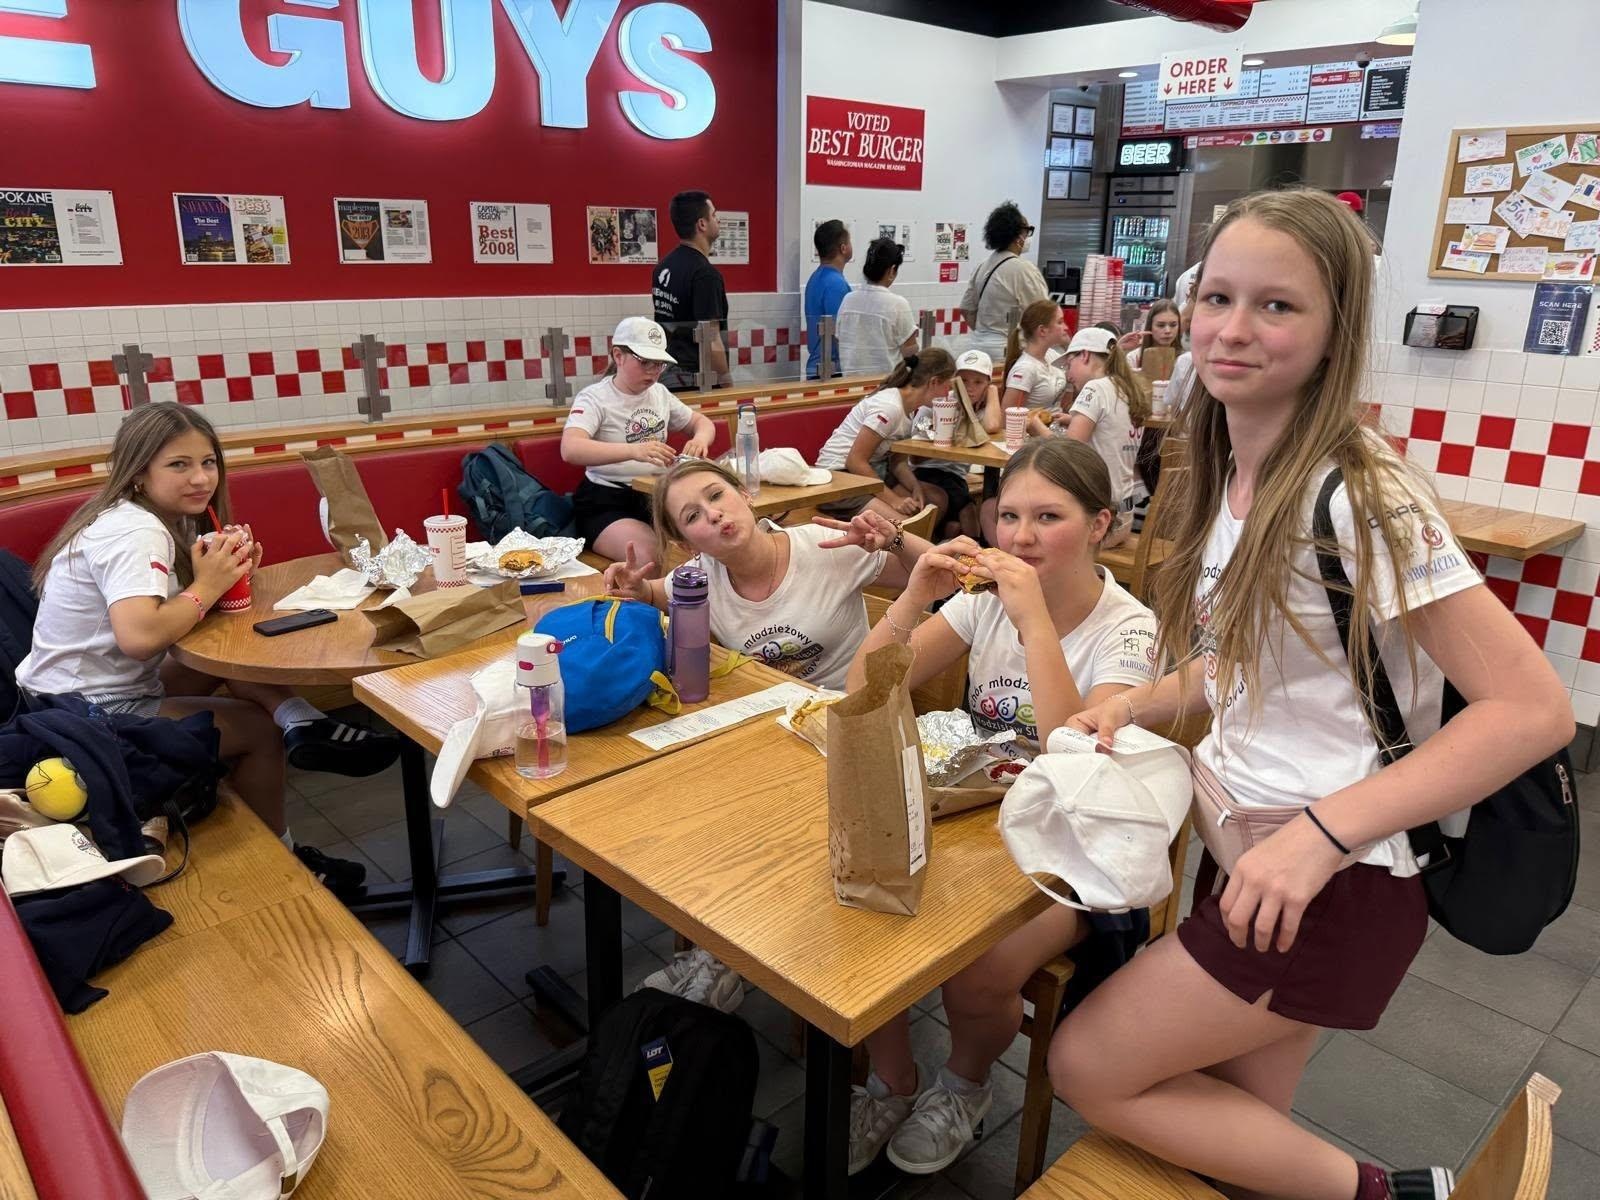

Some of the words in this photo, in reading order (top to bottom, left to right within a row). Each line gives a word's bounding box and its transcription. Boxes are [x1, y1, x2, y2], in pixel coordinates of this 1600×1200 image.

[177, 0, 717, 140] GUYS
[1170, 57, 1228, 78] ORDER
[1177, 78, 1217, 95] HERE
[847, 111, 891, 132] VOTED
[808, 128, 855, 156] BEST
[857, 133, 922, 163] BURGER
[1120, 142, 1171, 165] BEER
[826, 159, 864, 169] WASHINGTONIAN
[864, 161, 886, 170] MAGAZINE
[886, 164, 907, 172] READERS
[234, 199, 271, 213] Best
[4, 215, 45, 228] CITY
[477, 212, 501, 221] REGION
[477, 224, 514, 240] Best
[479, 241, 516, 255] 2008
[743, 623, 813, 650] młodzieżowy
[646, 1045, 664, 1059] LOT
